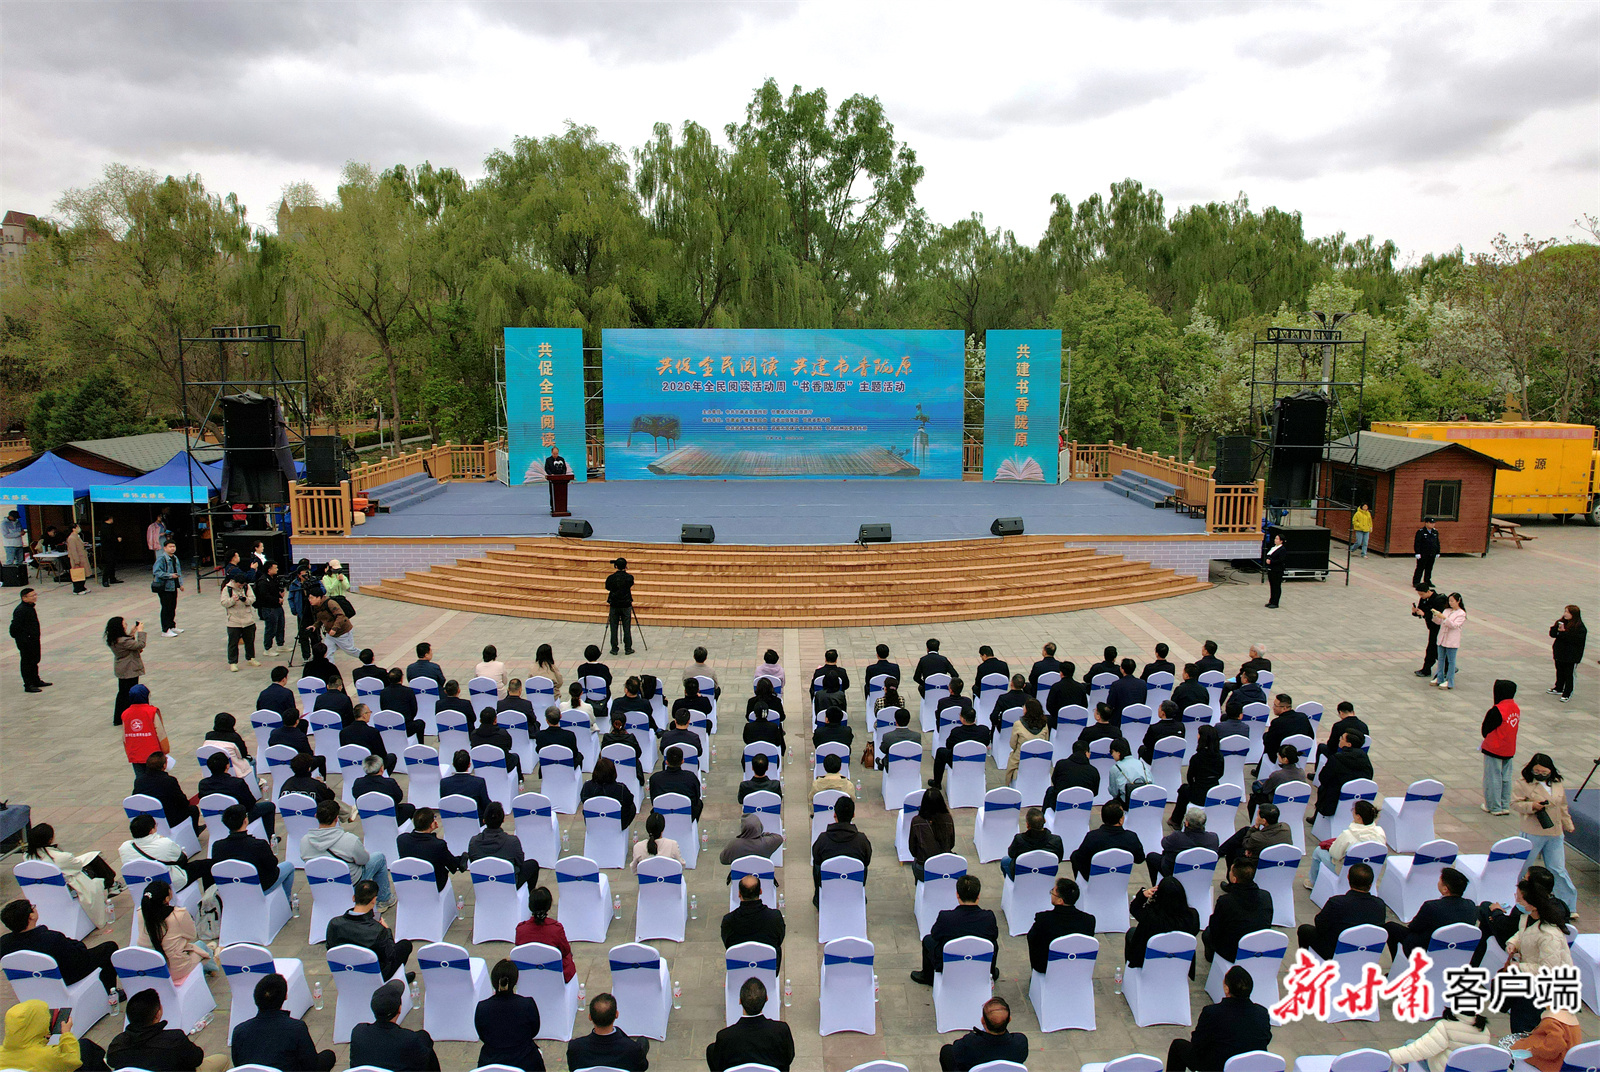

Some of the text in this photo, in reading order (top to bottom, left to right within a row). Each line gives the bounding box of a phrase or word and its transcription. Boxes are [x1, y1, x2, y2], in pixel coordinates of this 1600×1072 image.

[537, 342, 556, 447] 共促全民阅读
[656, 355, 914, 378] 共促全民阅读 共建书香陇原
[1013, 343, 1031, 447] 共建书香陇原
